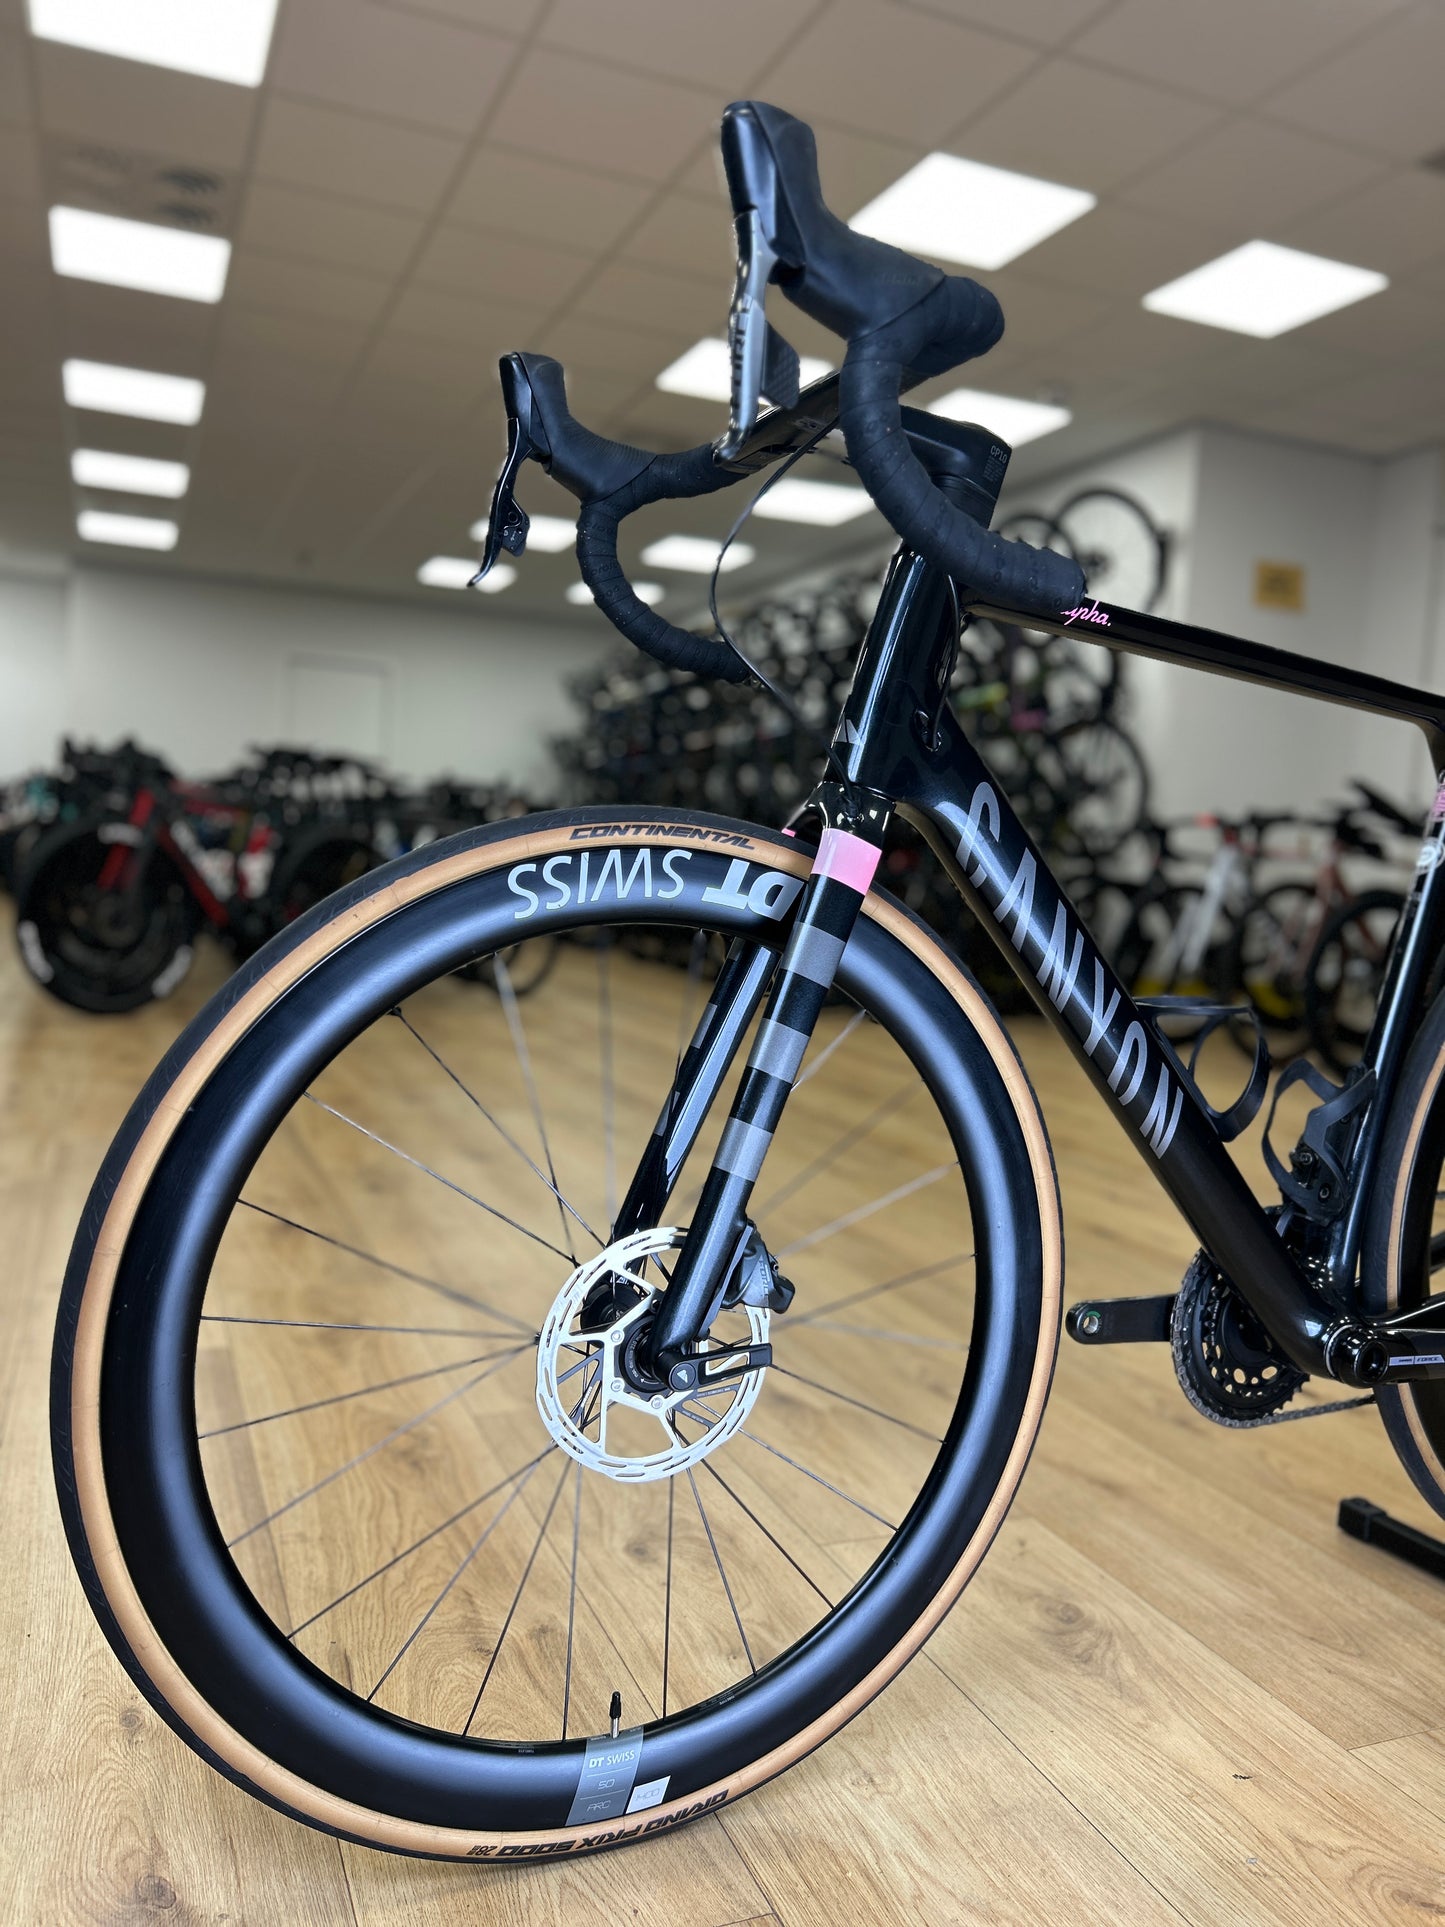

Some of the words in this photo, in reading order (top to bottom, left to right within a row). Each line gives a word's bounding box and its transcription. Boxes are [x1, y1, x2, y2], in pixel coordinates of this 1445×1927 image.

[1060, 599, 1111, 626] apha.
[569, 824, 755, 850] CONTINENTAL
[507, 848, 693, 919] SWISS
[701, 858, 805, 921] DT
[955, 781, 1184, 1159] CANYON
[588, 1757, 605, 1769] DT
[606, 1749, 635, 1766] SWISS
[587, 1800, 612, 1812] ARC
[644, 1789, 730, 1832] GRAND
[495, 1840, 576, 1857] 5000
[577, 1824, 643, 1850] PRIX
